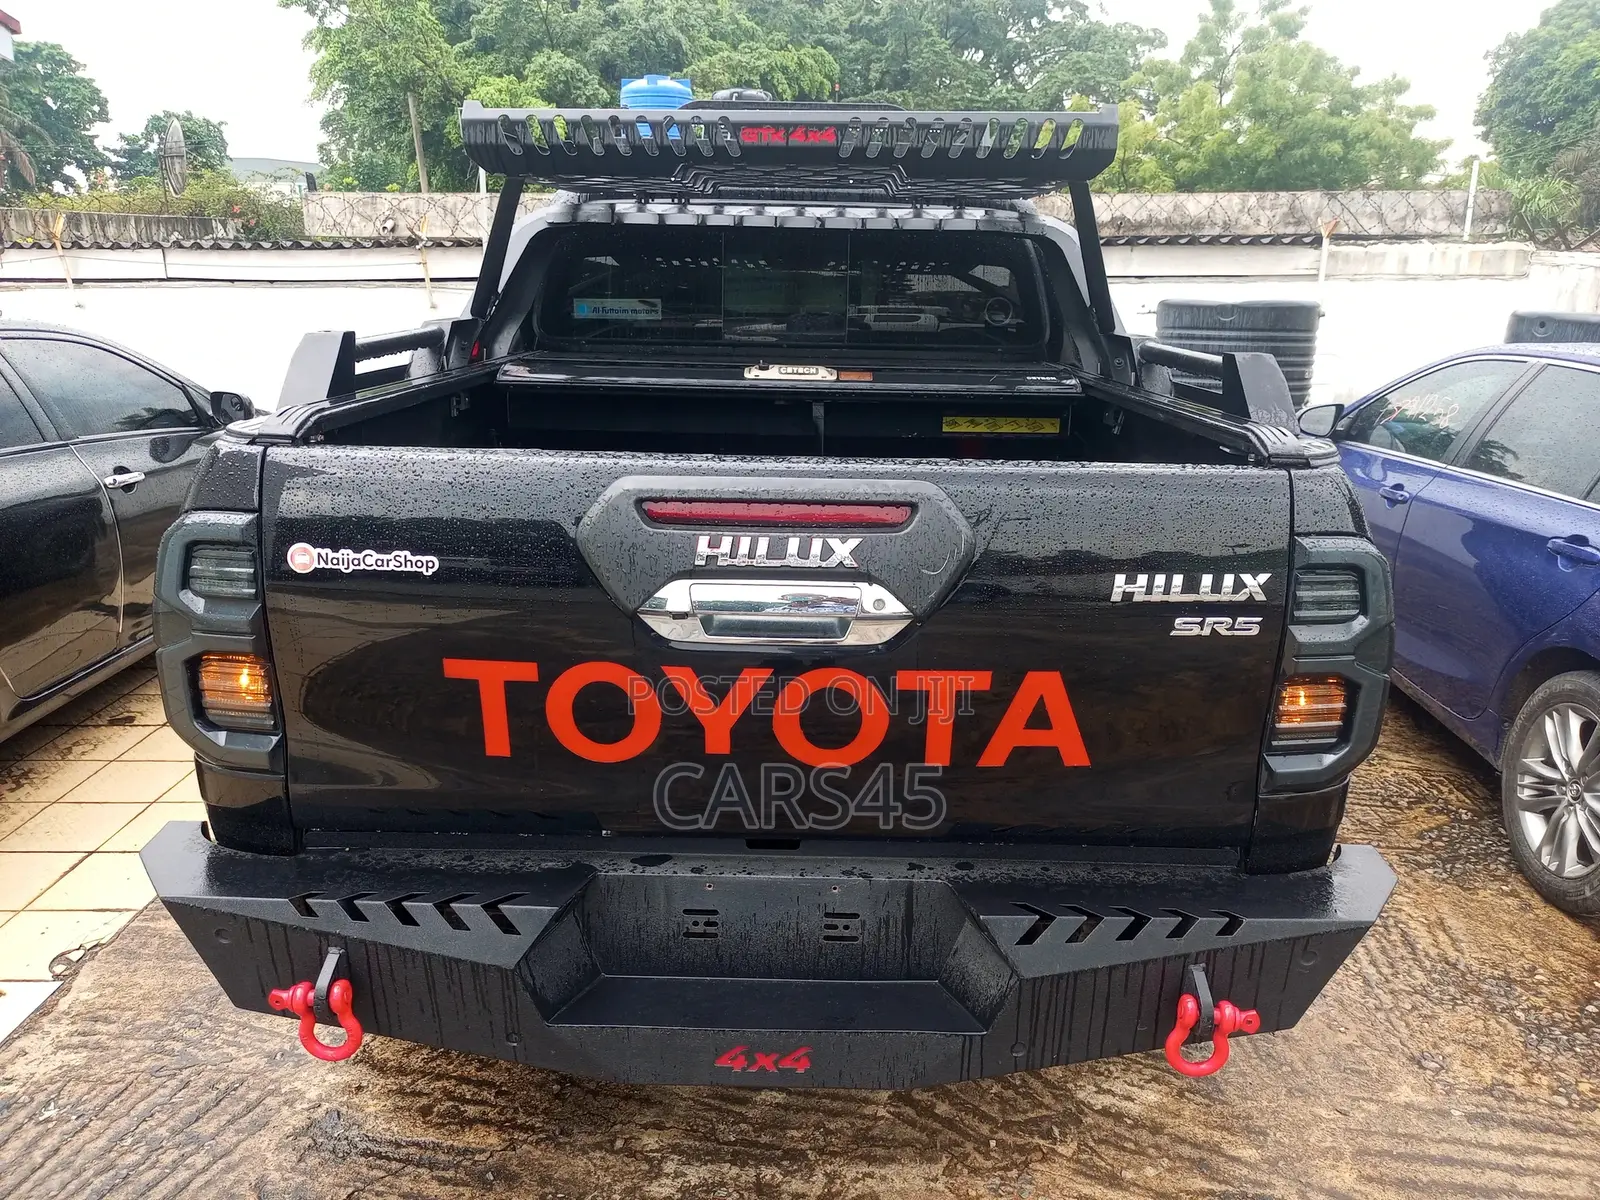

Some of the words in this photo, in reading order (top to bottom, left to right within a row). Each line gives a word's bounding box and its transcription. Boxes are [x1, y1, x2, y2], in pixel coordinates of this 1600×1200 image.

[317, 552, 436, 573] NaijaCarShop
[694, 535, 865, 568] HILUX
[1110, 573, 1272, 603] HILUX
[1169, 616, 1264, 637] SR5
[443, 657, 1091, 768] TOYOTA
[714, 1045, 814, 1074] 4x4
